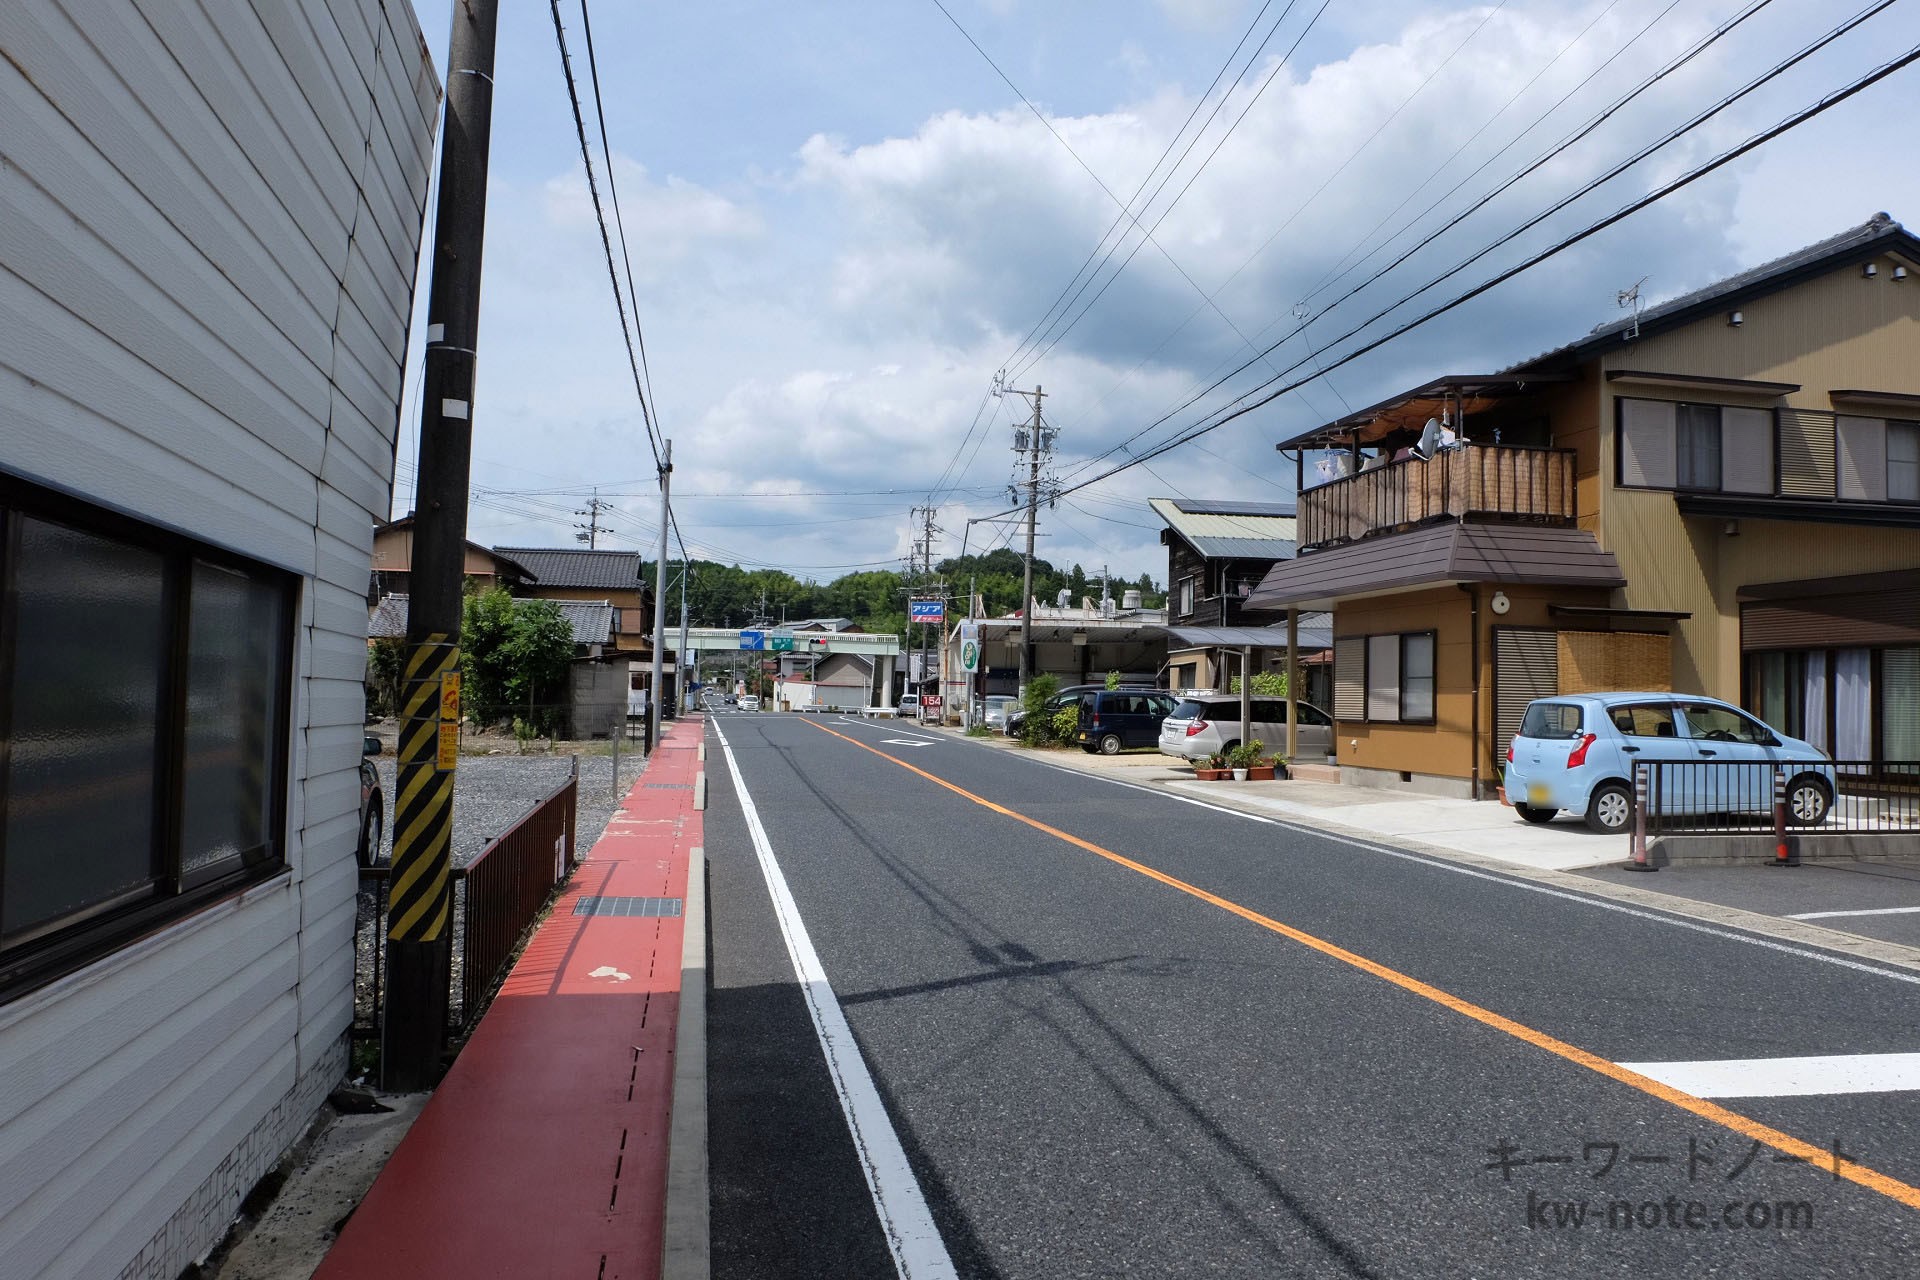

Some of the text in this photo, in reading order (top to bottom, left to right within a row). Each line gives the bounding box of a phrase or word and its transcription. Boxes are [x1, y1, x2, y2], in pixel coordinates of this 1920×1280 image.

[912, 605, 941, 613] アジア
[923, 696, 941, 705] 154
